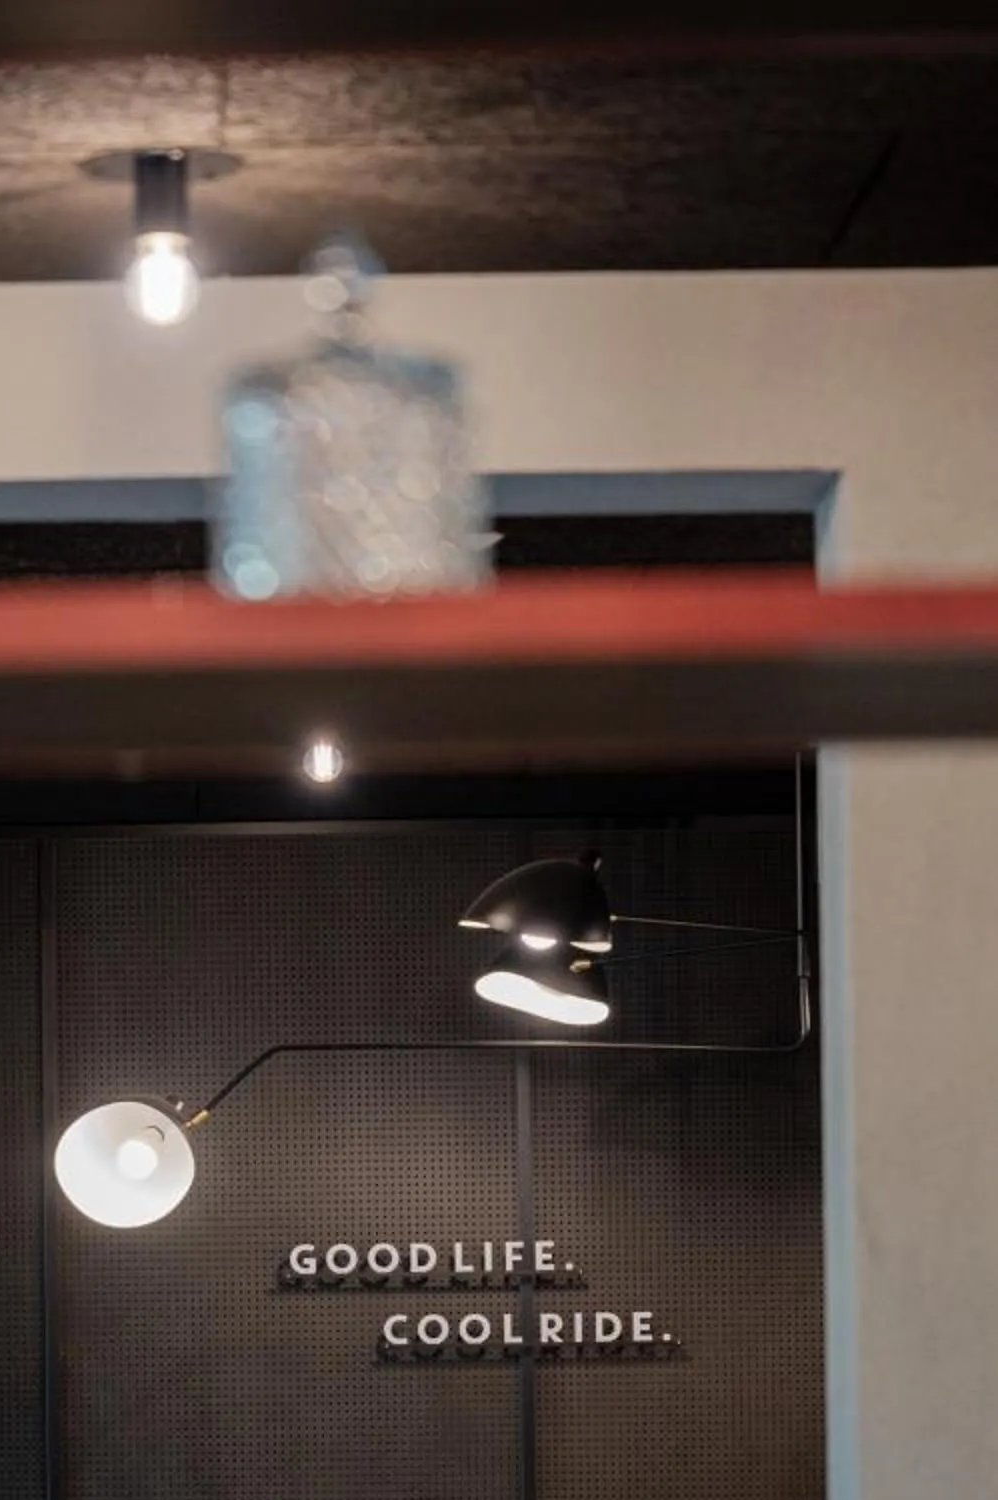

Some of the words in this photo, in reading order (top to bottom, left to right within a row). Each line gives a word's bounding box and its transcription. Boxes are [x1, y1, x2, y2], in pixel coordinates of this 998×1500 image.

[288, 1242, 437, 1275] GOOD
[454, 1240, 575, 1273] LIFE.
[382, 1313, 523, 1345] COOL
[539, 1311, 671, 1343] RIDE.
